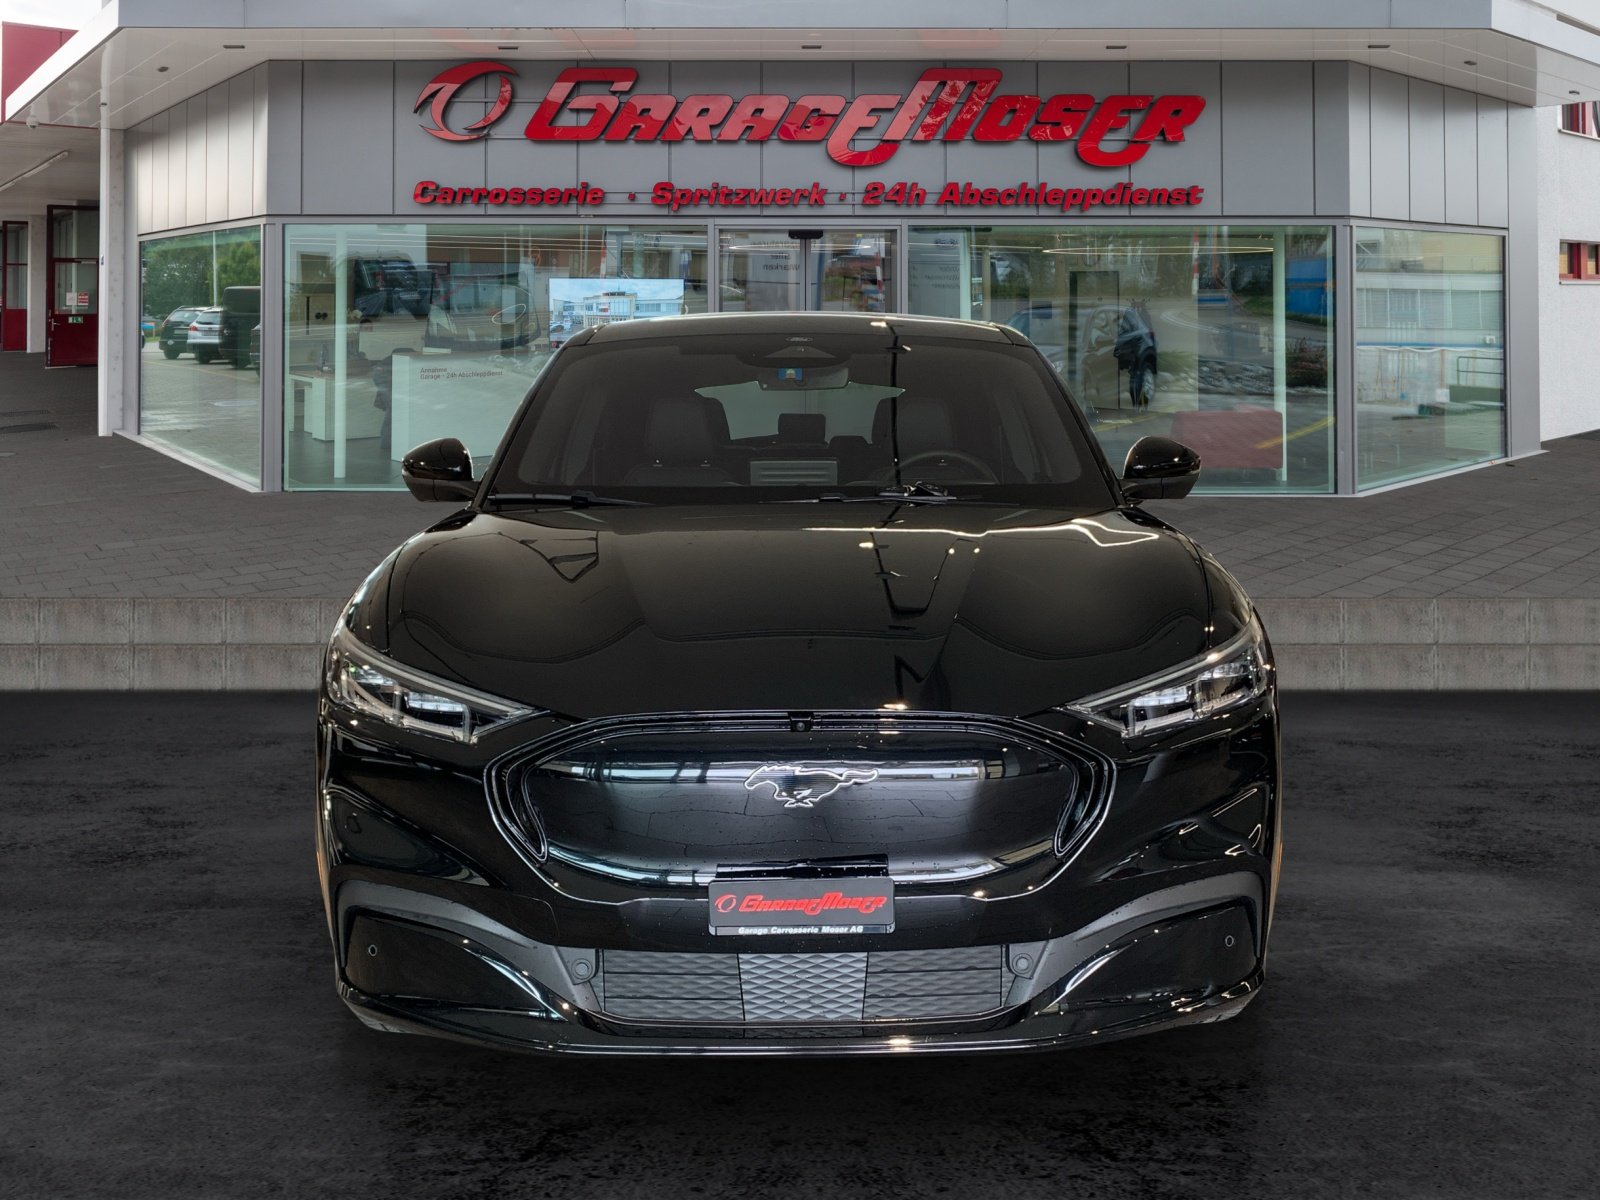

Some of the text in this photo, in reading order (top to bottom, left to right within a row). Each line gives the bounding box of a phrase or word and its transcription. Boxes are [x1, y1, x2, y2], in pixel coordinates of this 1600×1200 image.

[413, 181, 1204, 211] Carrosserie Spritzwerk 24h Abschleppdienst
[738, 926, 768, 935] Garage
[771, 926, 819, 934] Carrosserie
